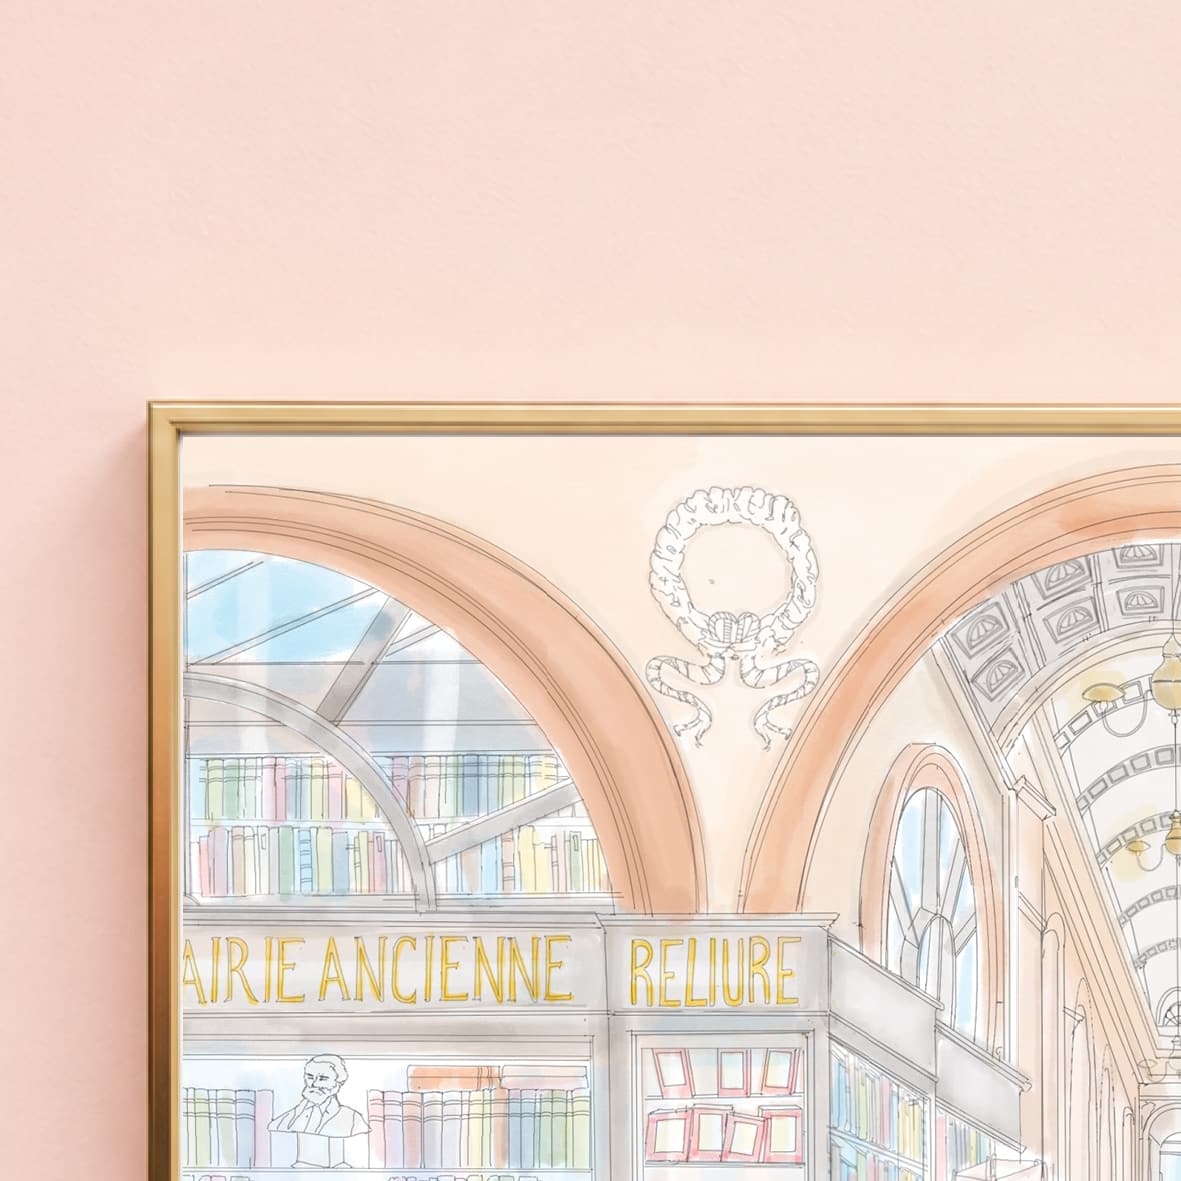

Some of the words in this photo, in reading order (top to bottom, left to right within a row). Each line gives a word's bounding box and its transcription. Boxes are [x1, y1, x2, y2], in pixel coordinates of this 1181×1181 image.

[183, 936, 306, 1005] AIRIE
[318, 935, 574, 1004] ANCIENNE
[630, 936, 802, 1007] RELIURE
